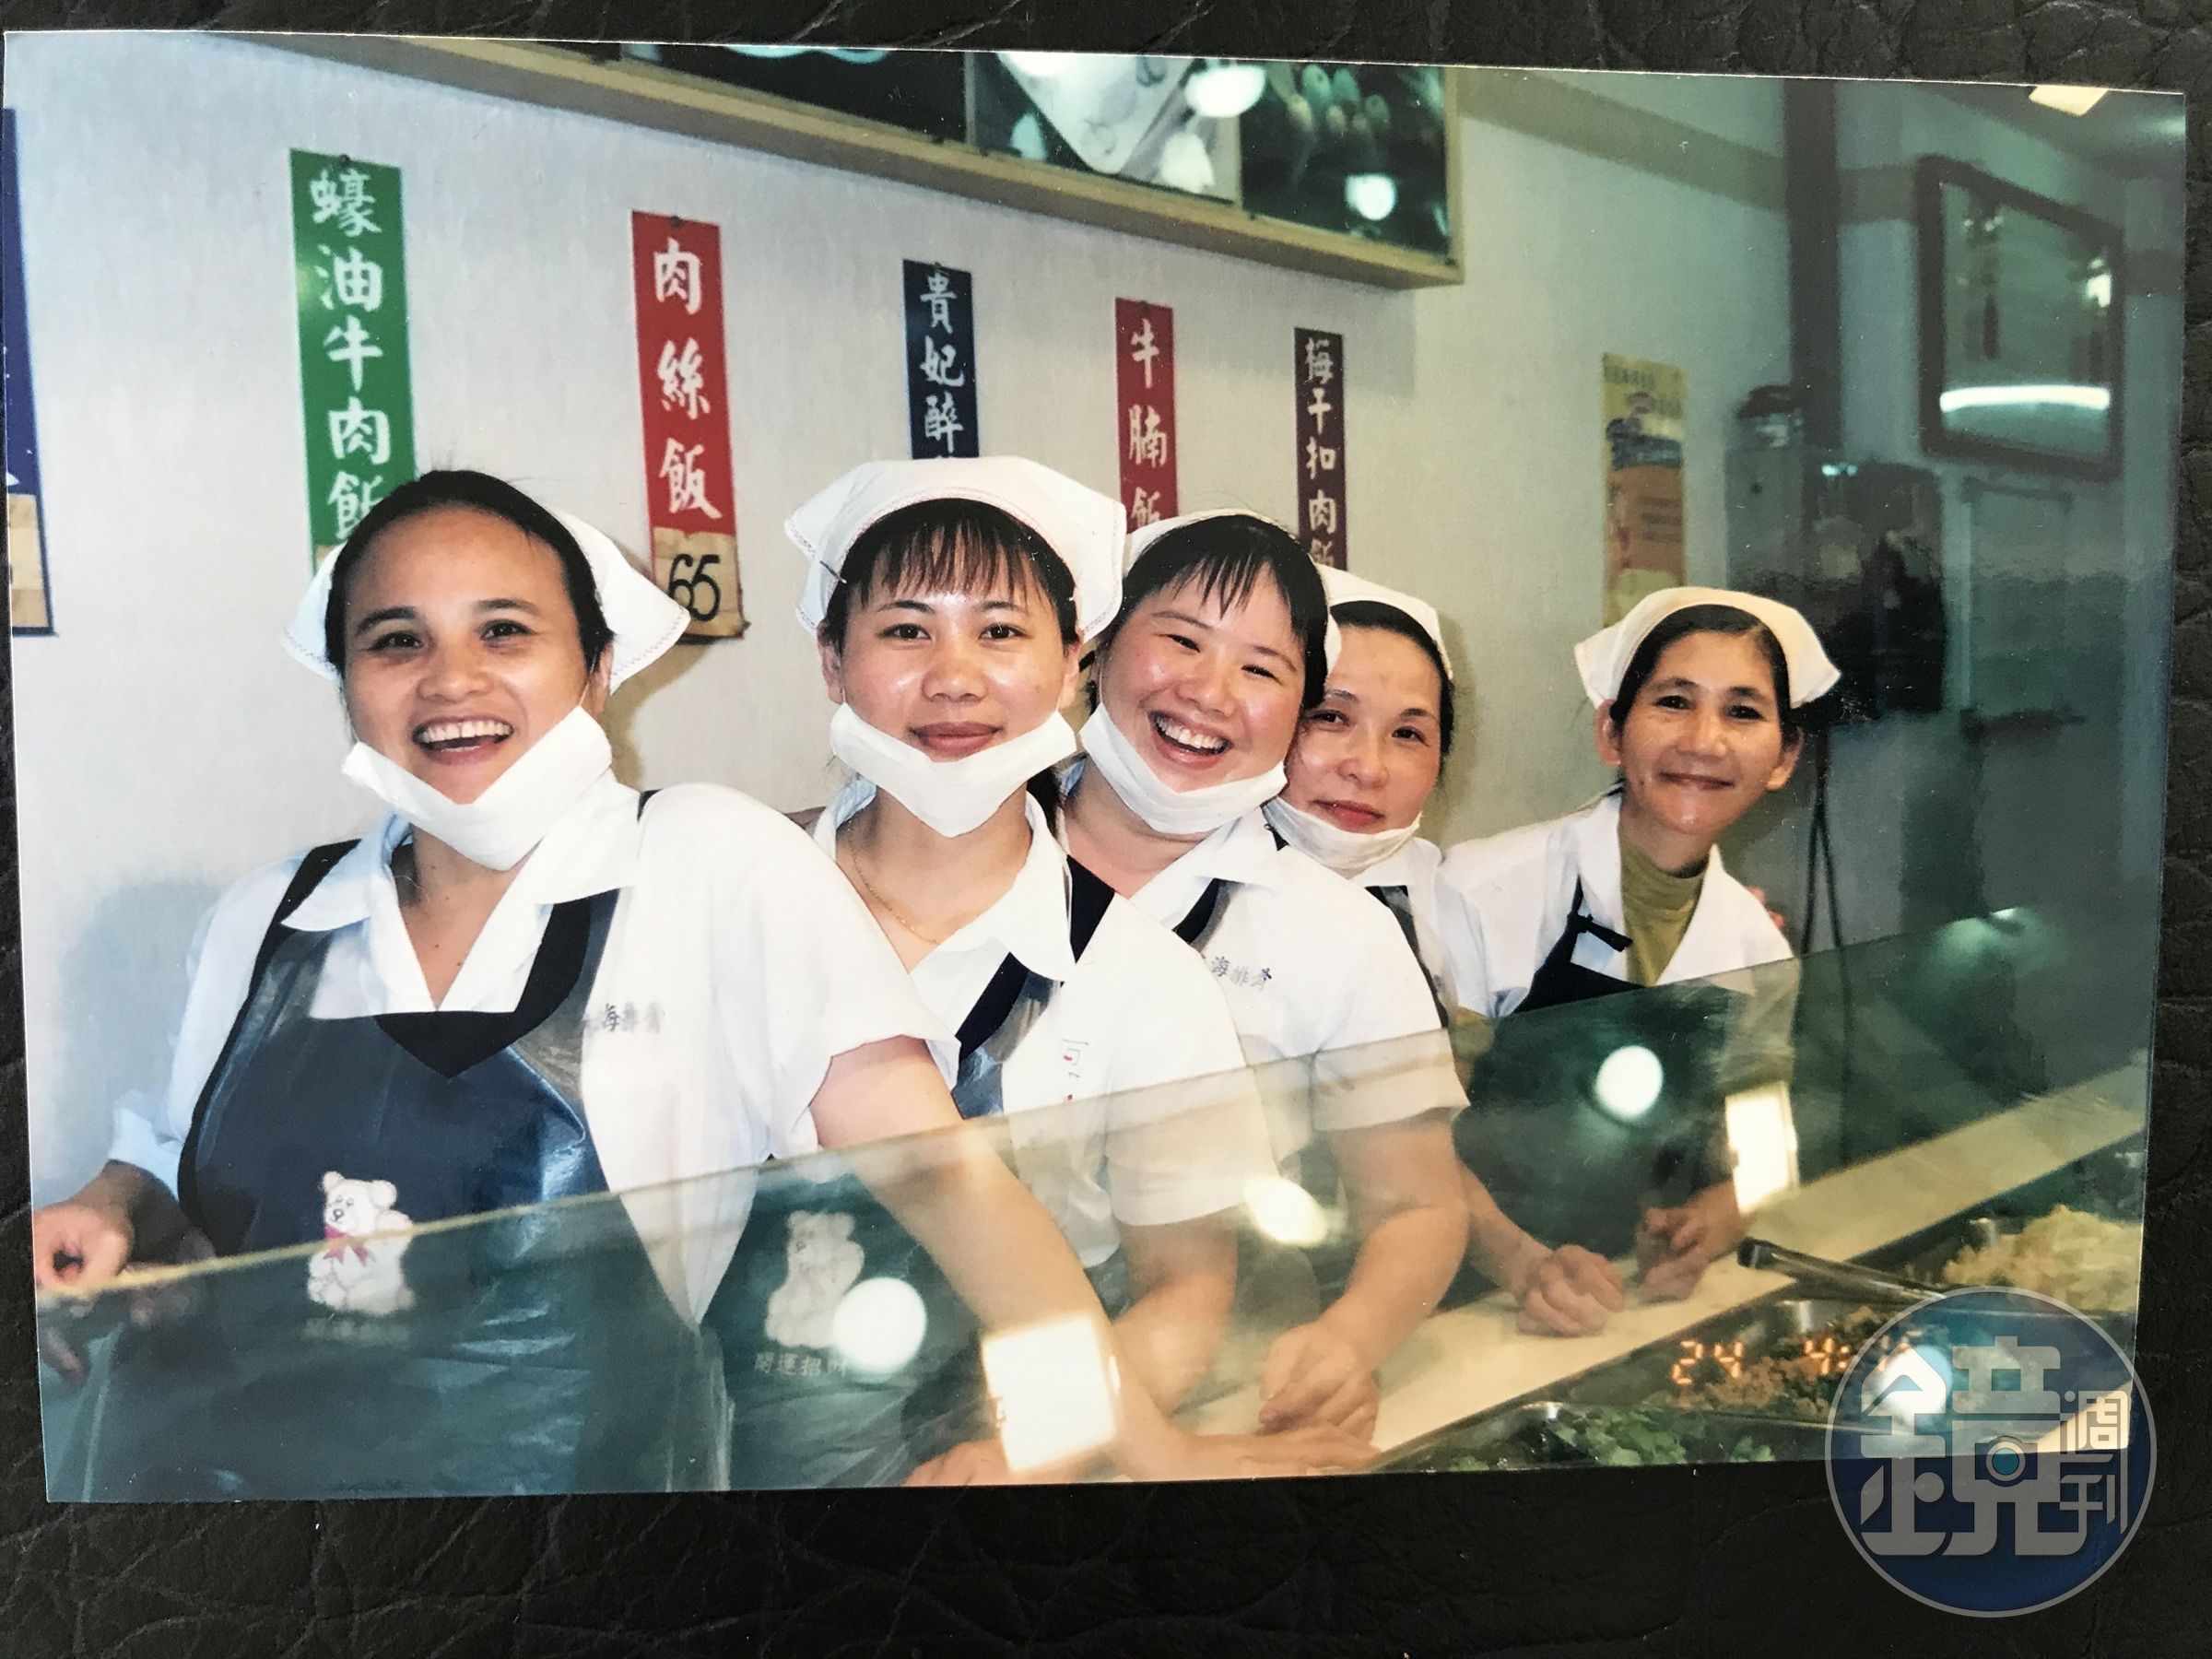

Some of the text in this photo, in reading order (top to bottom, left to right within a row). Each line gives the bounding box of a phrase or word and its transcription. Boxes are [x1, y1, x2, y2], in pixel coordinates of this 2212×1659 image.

[653, 236, 724, 519] 肉絲飯
[920, 272, 966, 459] 貴妃醉
[668, 553, 722, 622] 65
